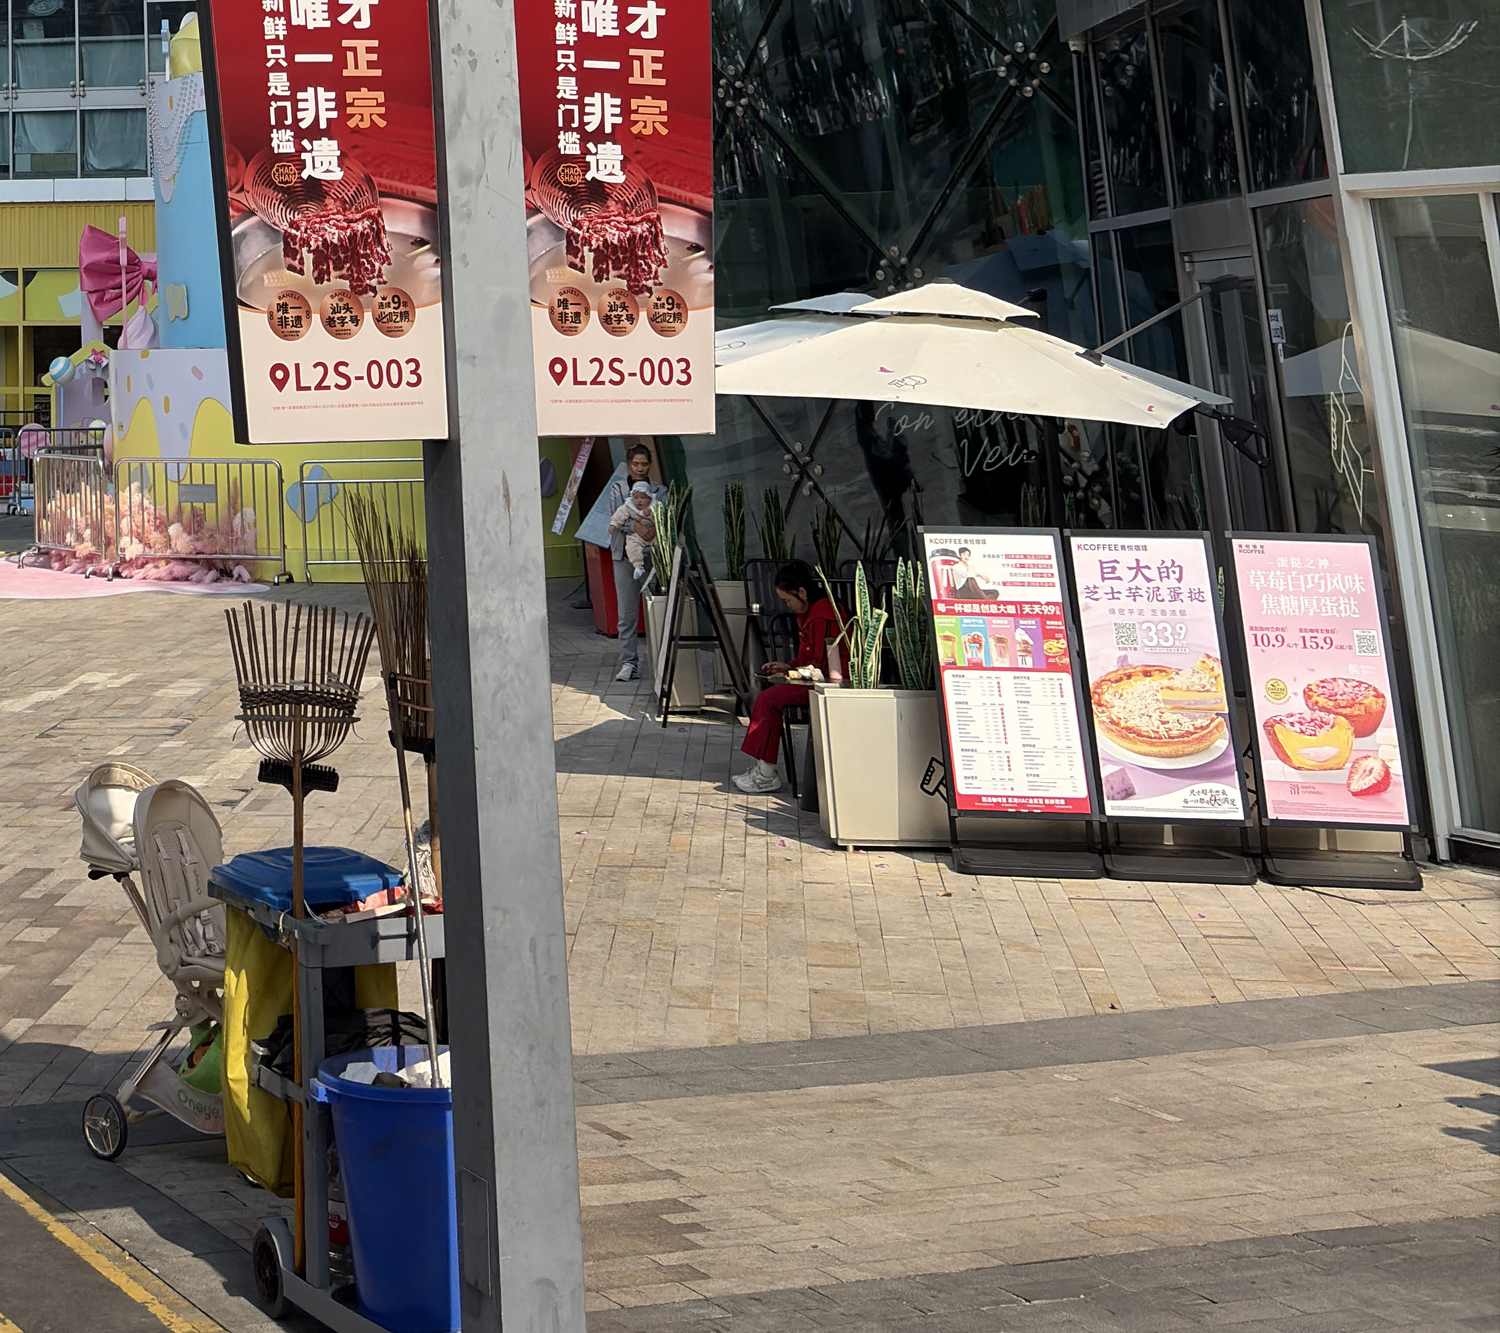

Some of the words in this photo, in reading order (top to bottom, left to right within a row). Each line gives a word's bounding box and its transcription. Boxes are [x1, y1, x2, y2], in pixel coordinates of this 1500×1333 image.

[625, 0, 669, 136] 才正宗
[276, 302, 302, 314] 唯一
[330, 303, 353, 314] 汕头
[557, 299, 581, 310] 唯一
[607, 302, 629, 312] 汕头
[277, 315, 303, 329] 非遗
[325, 316, 360, 329] 老字号
[558, 312, 581, 324] 非遗
[602, 314, 636, 326] 老字号
[295, 357, 422, 392] L2S-003
[572, 357, 692, 386] L2S-003
[1077, 543, 1119, 551] KCOFFEE
[1276, 556, 1330, 569] 蛋挞之神
[1098, 558, 1184, 584] 巨大的
[1247, 570, 1366, 595] 草莓白巧风味
[1083, 584, 1207, 603] 芝士芋泥蛋挞
[1260, 593, 1360, 618] 焦糖厚蛋挞
[1141, 621, 1187, 647] 33.9
[1252, 633, 1285, 648] 10.9
[1300, 635, 1334, 650] 15.9
